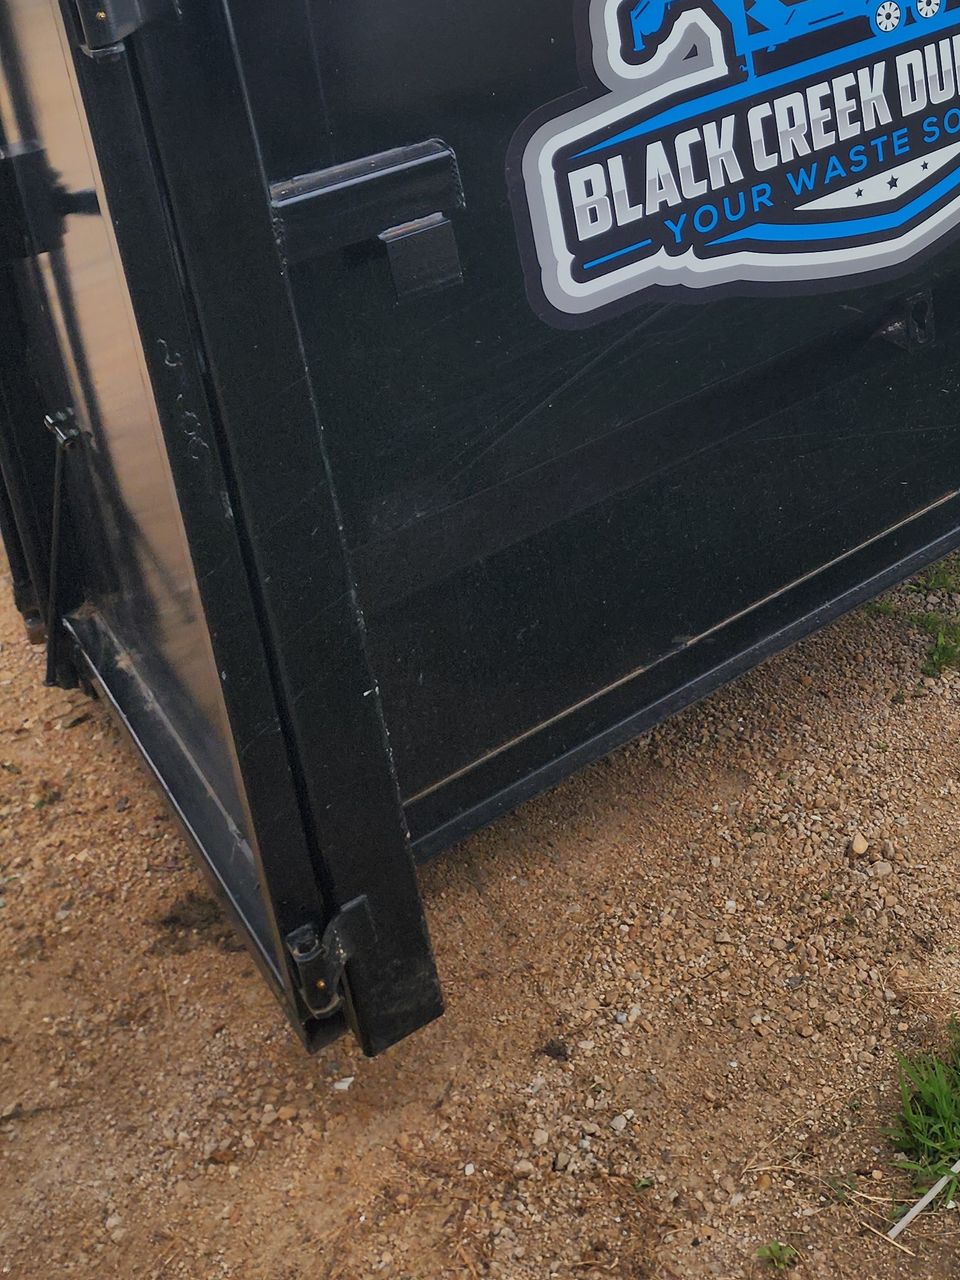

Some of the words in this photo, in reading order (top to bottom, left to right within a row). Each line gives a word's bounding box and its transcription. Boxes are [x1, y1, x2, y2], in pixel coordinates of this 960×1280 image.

[567, 114, 744, 242] BLACK
[747, 61, 893, 172] CREEK
[663, 183, 774, 244] YOUR
[785, 128, 910, 196] WASTE
